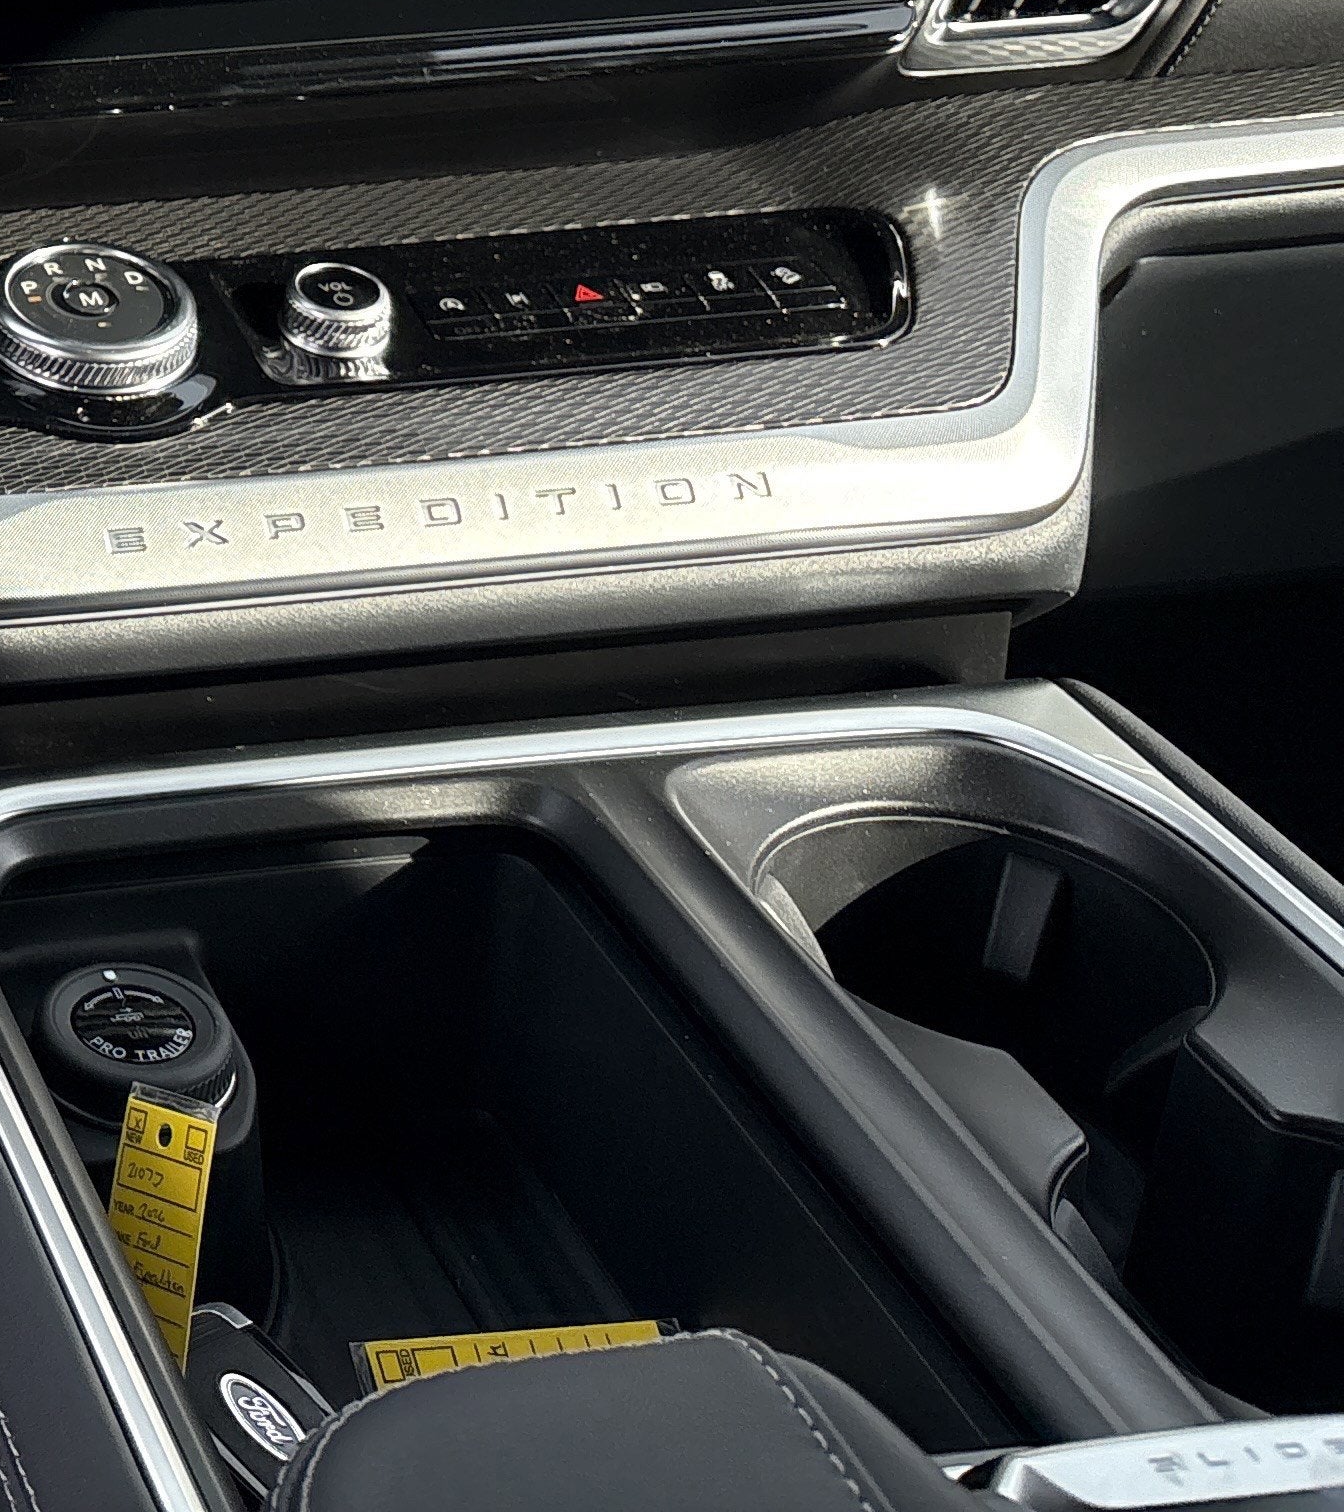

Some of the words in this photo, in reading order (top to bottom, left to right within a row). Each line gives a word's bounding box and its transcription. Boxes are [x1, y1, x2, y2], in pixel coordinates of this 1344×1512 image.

[42, 261, 64, 278] R
[84, 256, 106, 272] N
[126, 270, 143, 286] D
[19, 280, 37, 297] P
[317, 280, 353, 294] VOL
[80, 290, 104, 307] M
[105, 470, 776, 556] EXPEDITION
[89, 1035, 127, 1060] PRO
[132, 1027, 194, 1063] TRAILER
[183, 1148, 205, 1166] USED
[113, 1198, 135, 1216] YEAR
[237, 1395, 295, 1446] Ford
